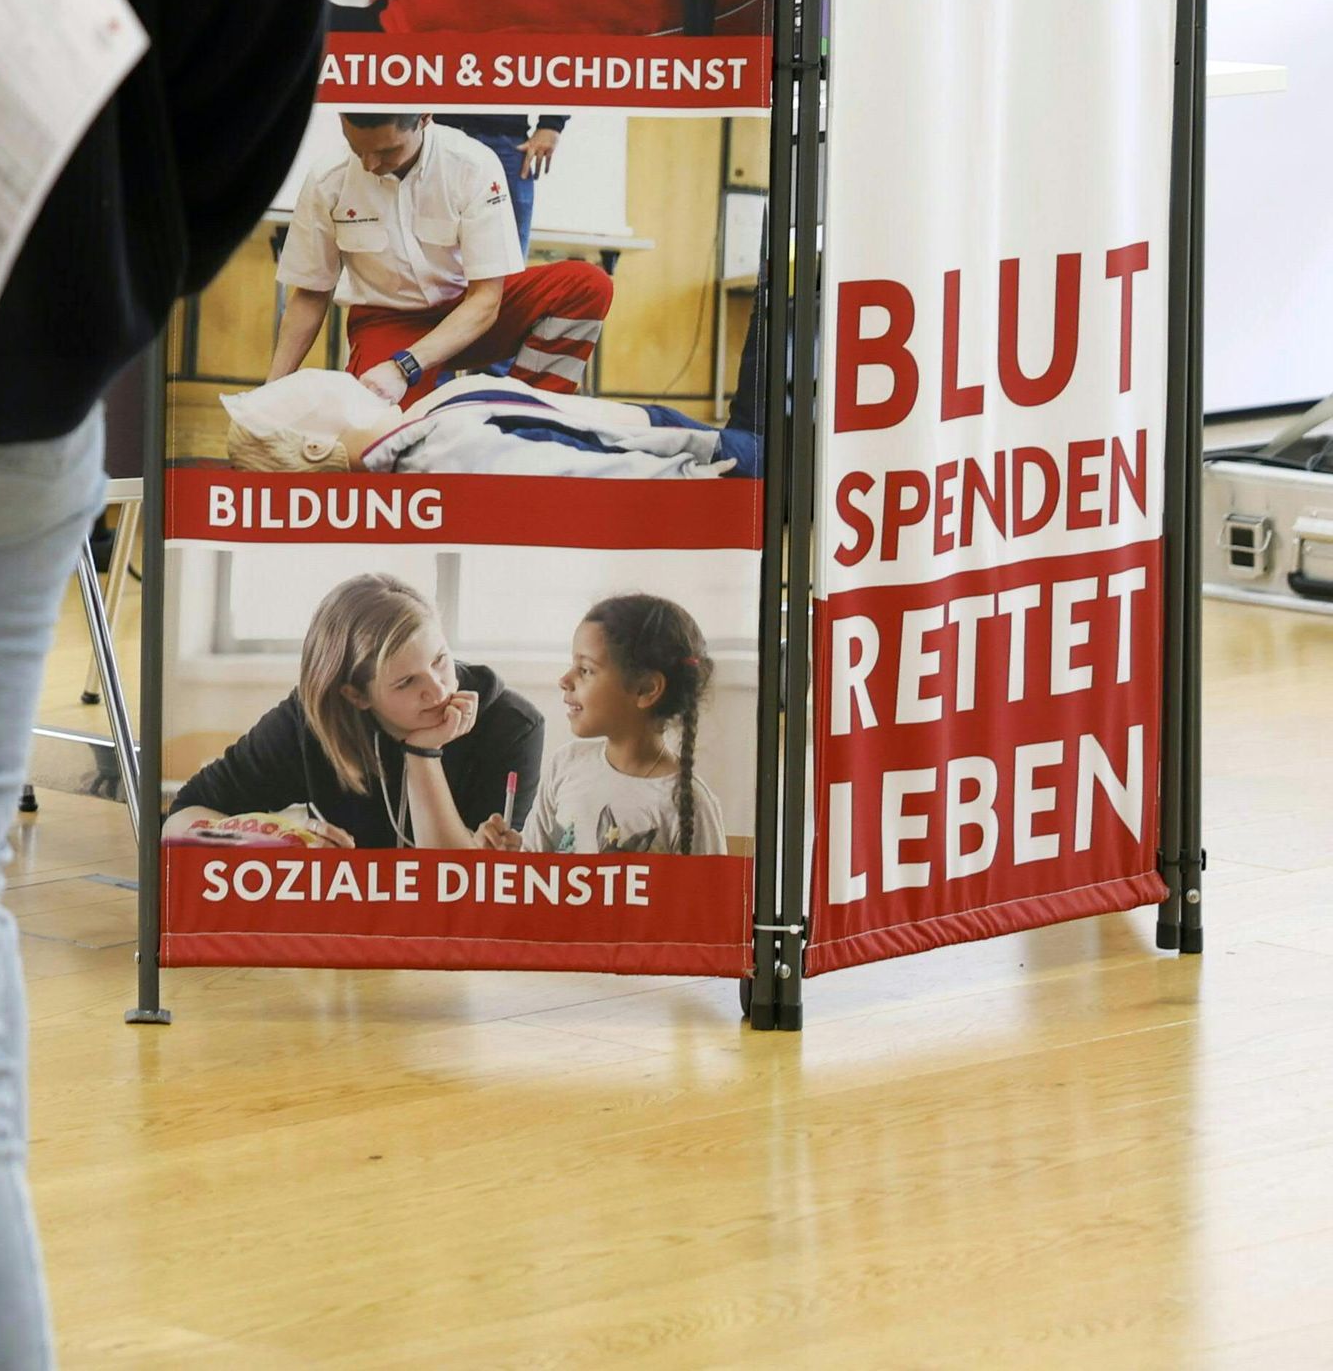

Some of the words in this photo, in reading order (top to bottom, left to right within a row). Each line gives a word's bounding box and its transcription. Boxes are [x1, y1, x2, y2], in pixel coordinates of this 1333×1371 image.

[317, 53, 445, 87] ATION
[455, 53, 483, 87] &
[492, 55, 748, 90] SUCHDIENST
[833, 240, 1150, 434] BLUT
[209, 485, 443, 530] BILDUNG
[833, 429, 1148, 568] SPENDEN
[829, 566, 1147, 737] RETTET
[202, 860, 420, 902] SOZIALE
[437, 862, 650, 906] DIENSTE
[827, 724, 1145, 907] LEBEN
